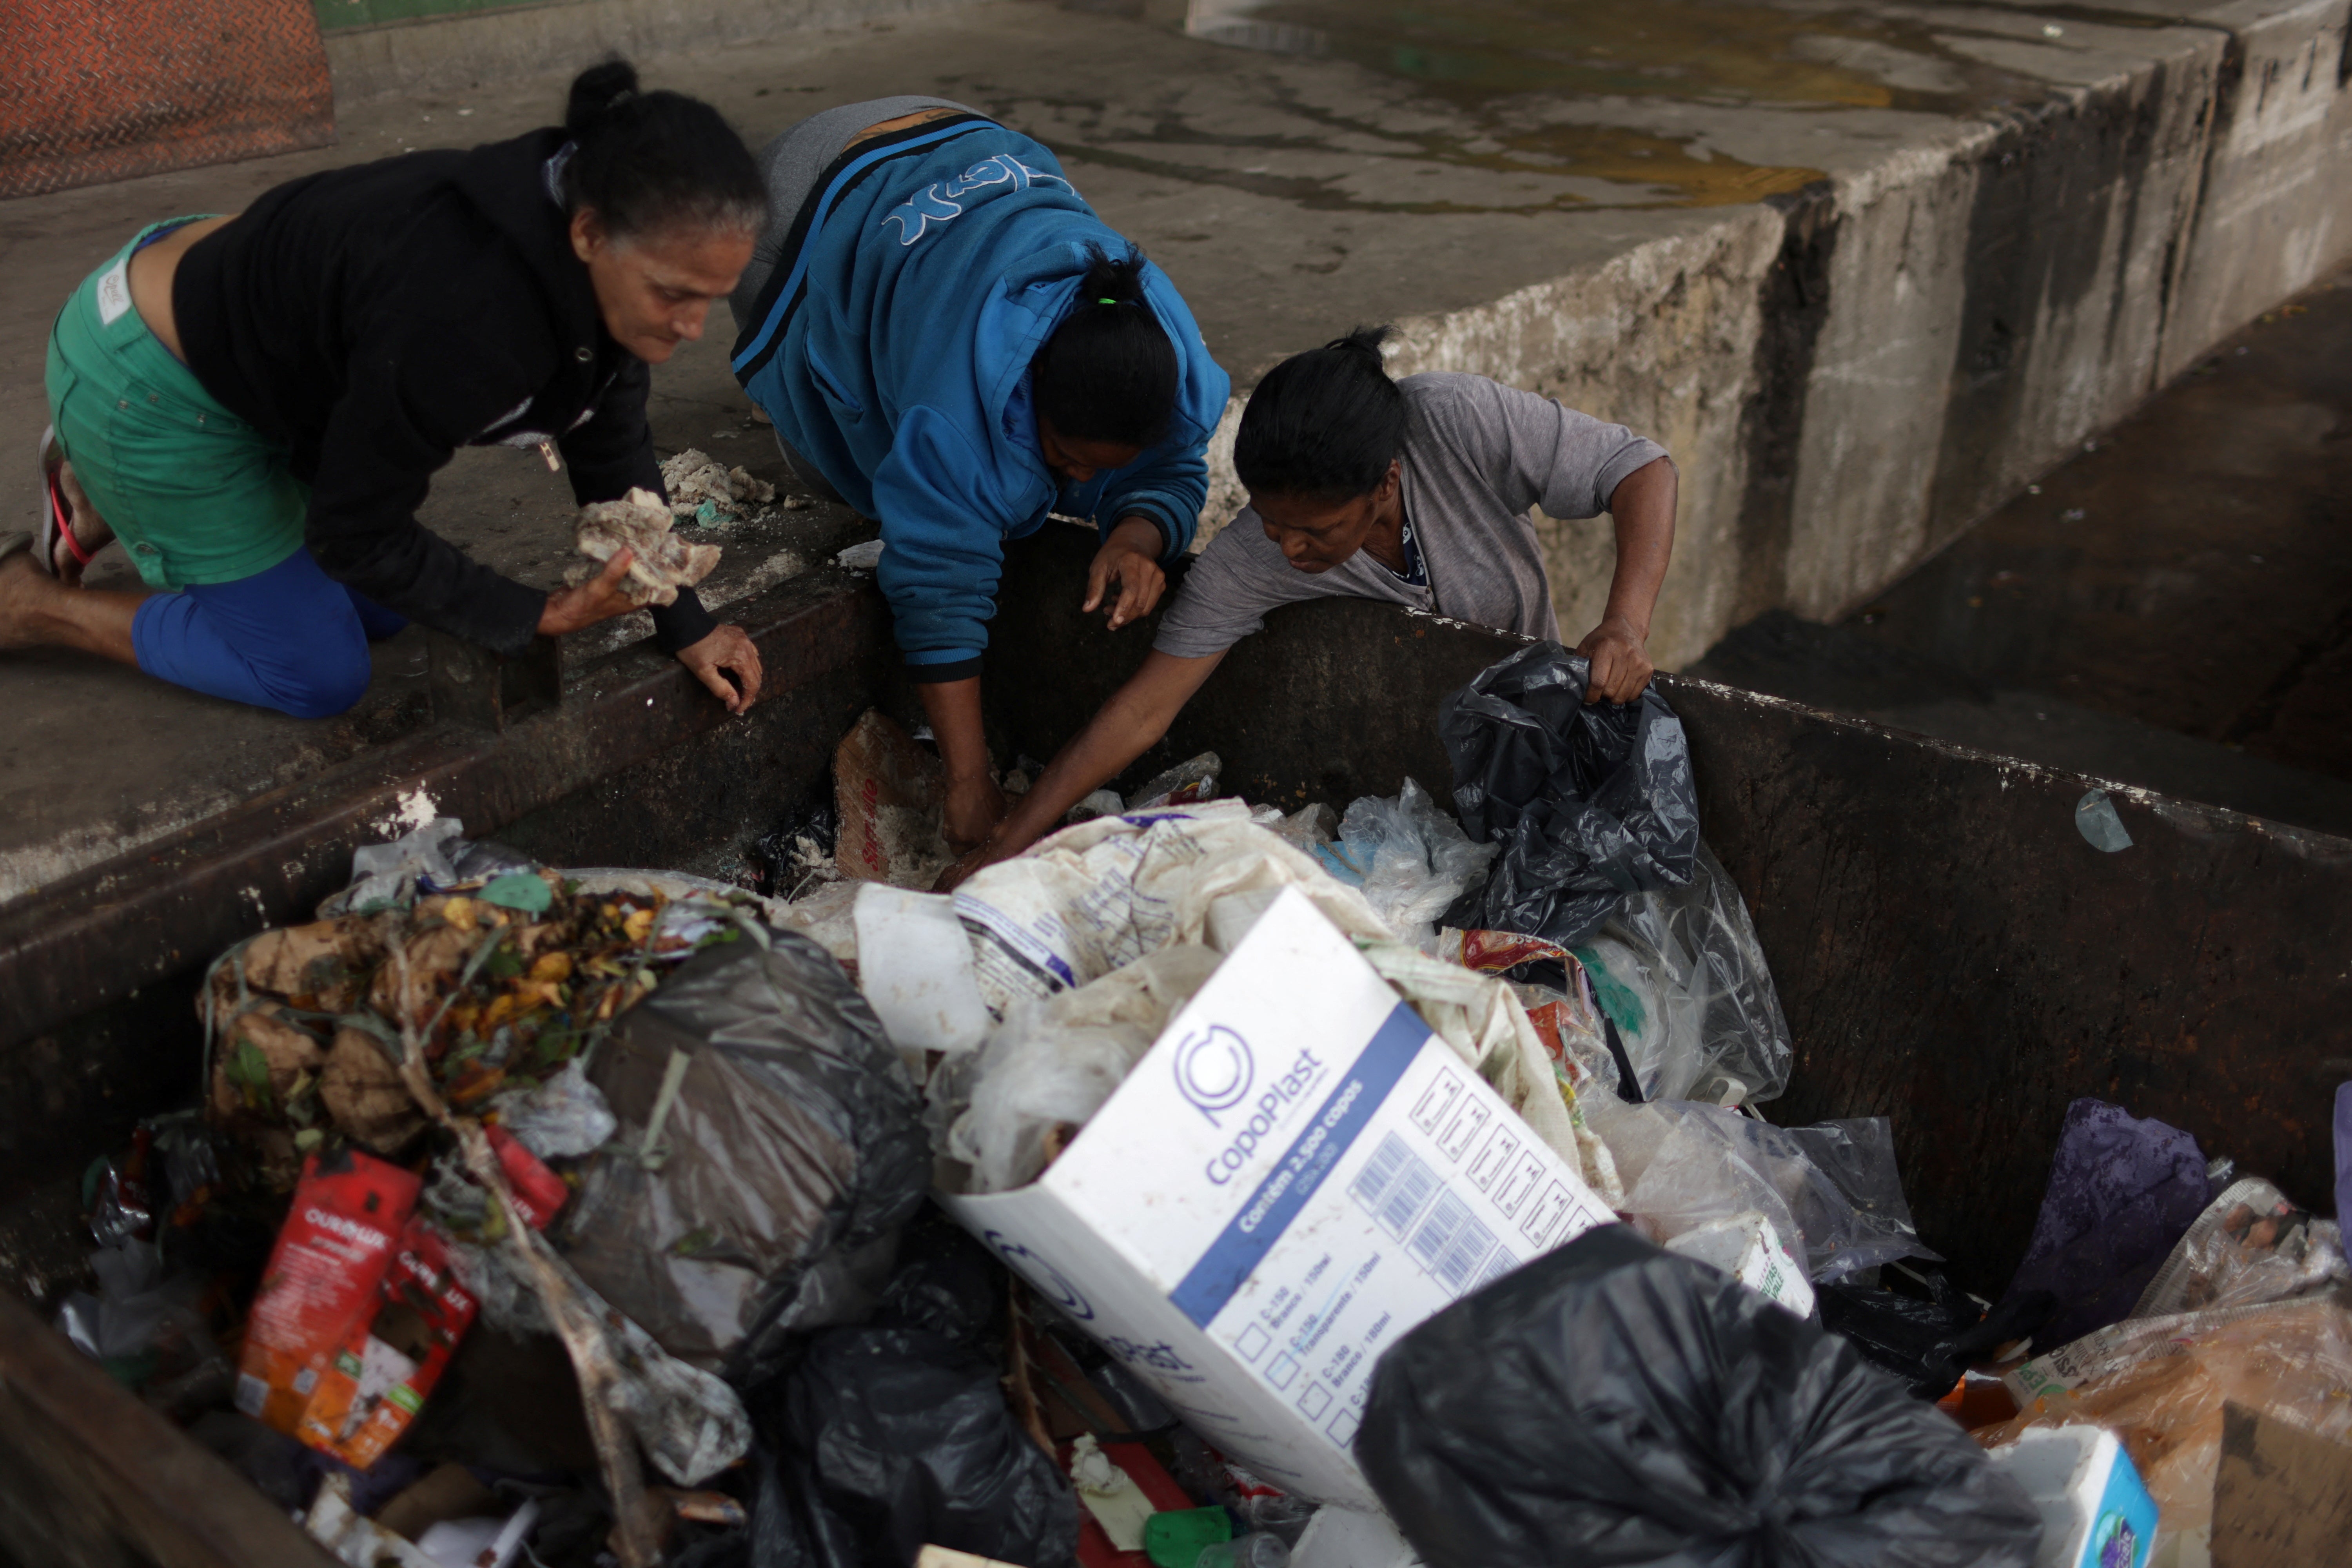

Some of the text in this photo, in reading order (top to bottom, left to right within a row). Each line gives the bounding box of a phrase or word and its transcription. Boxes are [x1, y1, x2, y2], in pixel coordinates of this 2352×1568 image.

[1207, 1049, 1321, 1184] CopoPlast
[1239, 1171, 1294, 1232] Contém
[1290, 1126, 1325, 1171] 2.500
[1324, 1079, 1362, 1127] copos
[1261, 1287, 1289, 1319] C-150
[1771, 1275, 1784, 1299] VALE
[1270, 1294, 1302, 1328] Branco
[1300, 1291, 1352, 1356] Transparente
[1290, 1314, 1318, 1348] C-150
[1322, 1345, 1350, 1378] C-180
[1332, 1351, 1362, 1387] Branco
[1365, 1312, 1391, 1343] 180ml
